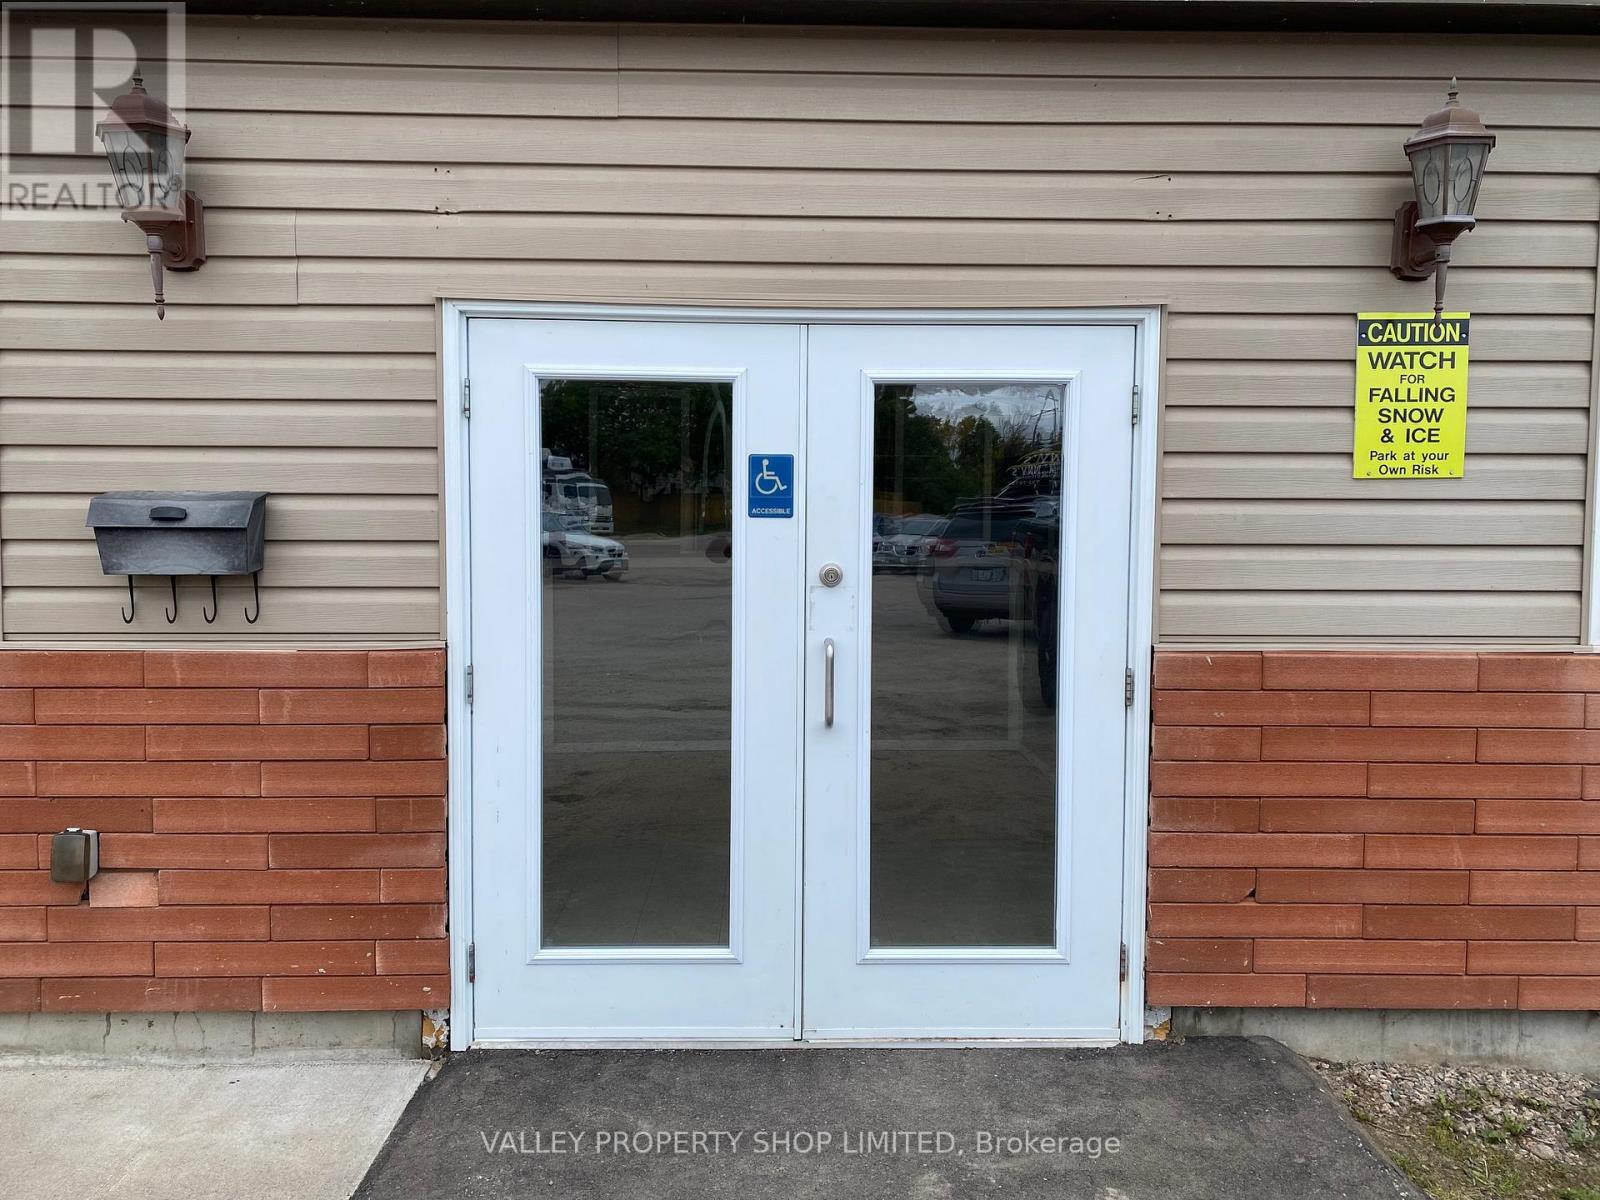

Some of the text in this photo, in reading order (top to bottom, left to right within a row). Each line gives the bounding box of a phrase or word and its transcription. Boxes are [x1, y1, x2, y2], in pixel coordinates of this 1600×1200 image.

[1367, 322, 1460, 343] CAUTION
[1368, 351, 1456, 370] WATCH
[1400, 374, 1425, 384] FOR
[1369, 387, 1456, 403] FALLING
[1378, 408, 1444, 424] SNOW
[1380, 428, 1441, 443] & ICE
[1370, 450, 1449, 463] Park at your
[1378, 464, 1439, 475] Own Risk
[751, 507, 791, 515] ACCESSIBLE
